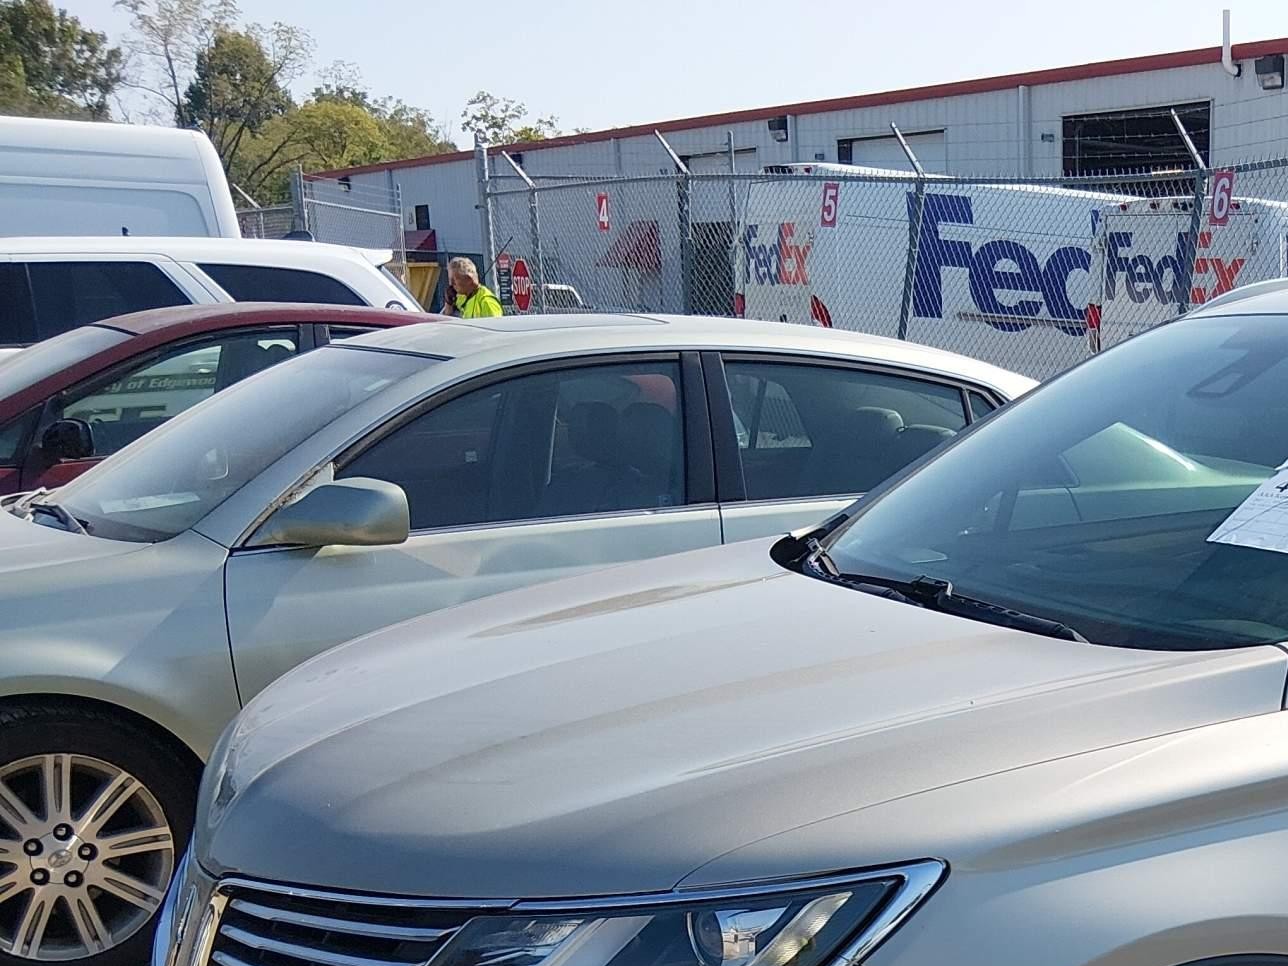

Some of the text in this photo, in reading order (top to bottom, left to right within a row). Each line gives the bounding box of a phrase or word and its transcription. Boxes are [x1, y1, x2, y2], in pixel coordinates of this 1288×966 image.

[599, 198, 609, 228] 4
[823, 188, 838, 222] 5
[1213, 178, 1230, 220] 6
[744, 221, 812, 285] FedEx
[1104, 231, 1245, 305] FedEx
[513, 276, 530, 295] STOP
[127, 380, 145, 390] of
